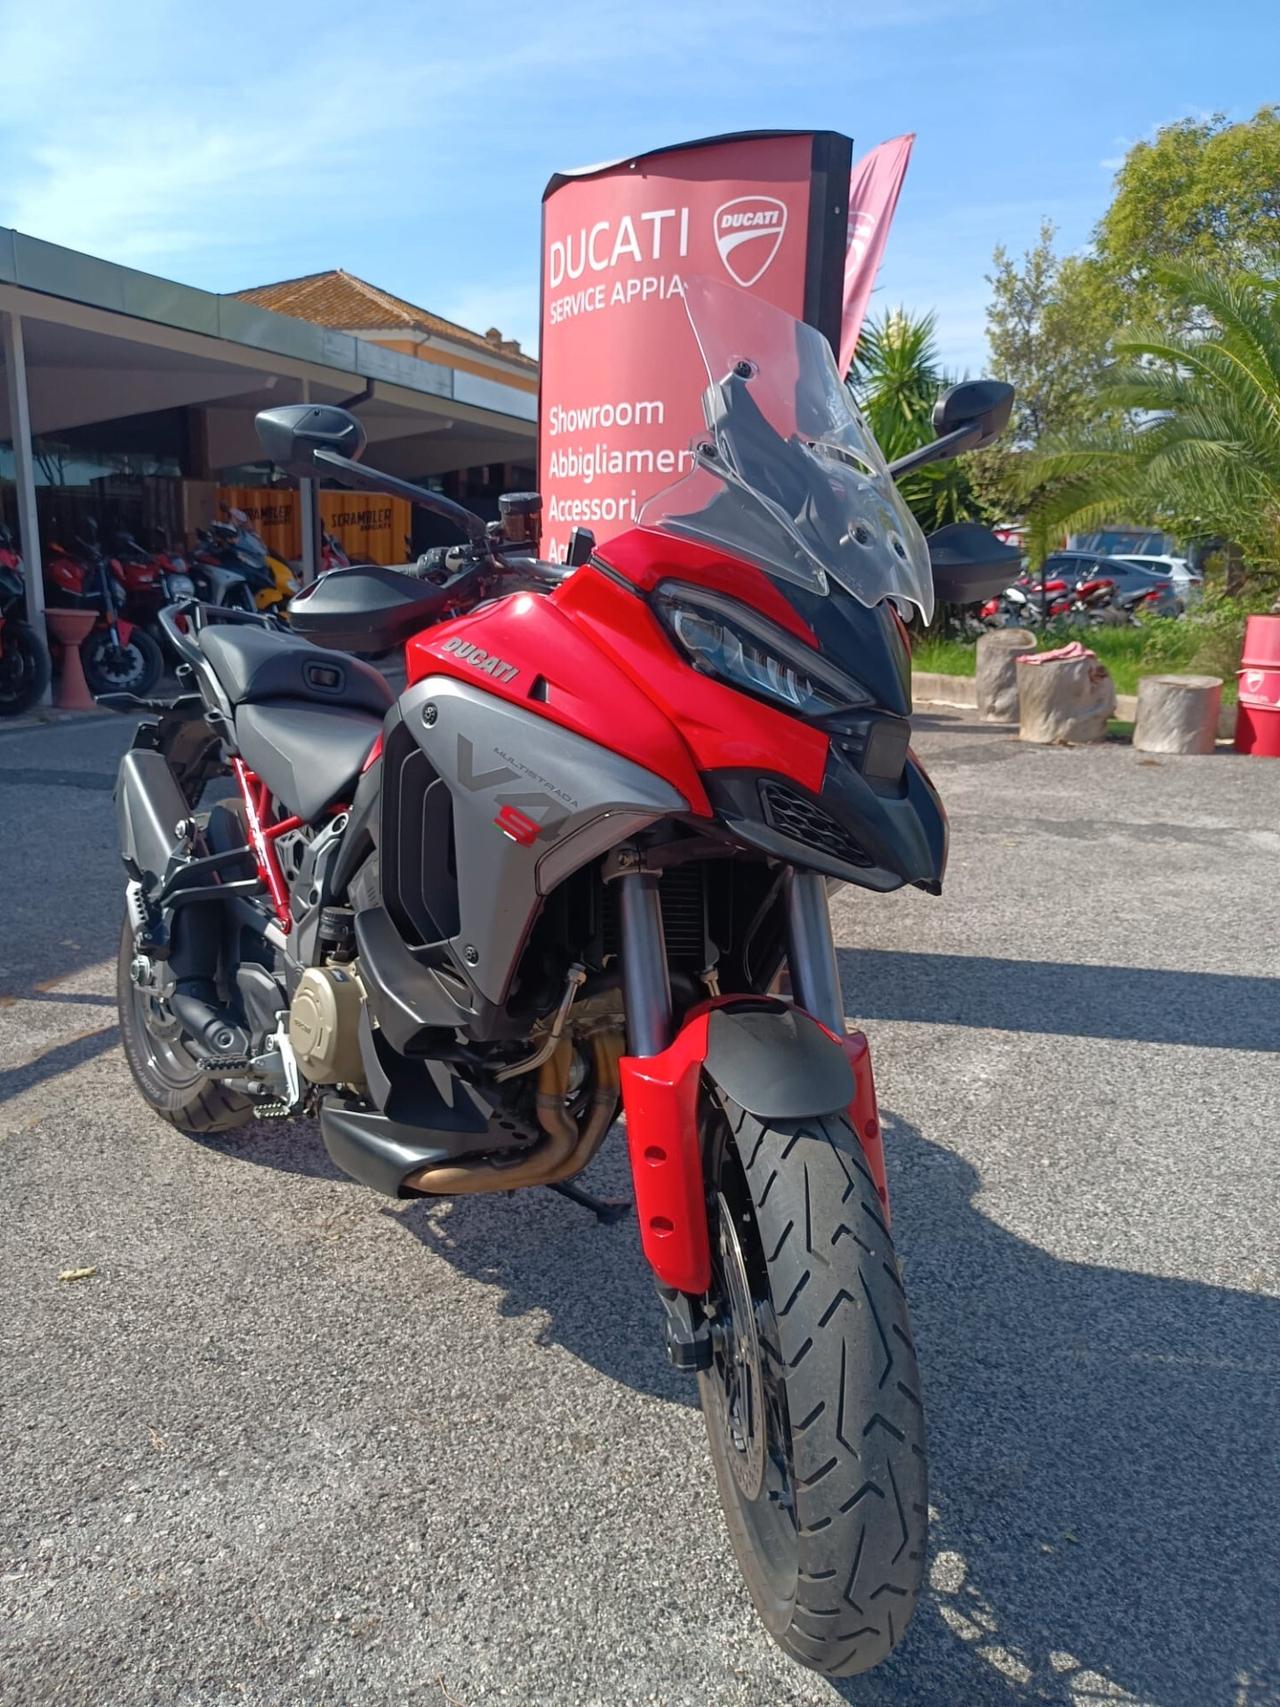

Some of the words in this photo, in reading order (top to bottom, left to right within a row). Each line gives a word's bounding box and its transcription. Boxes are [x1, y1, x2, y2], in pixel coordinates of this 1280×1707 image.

[721, 210, 779, 228] DUCATI
[550, 207, 689, 289] DUCATI
[550, 284, 606, 325] SERVICE
[610, 274, 685, 305] APPIA
[549, 400, 664, 436] Showroom
[331, 508, 392, 528] SCRAMBLER
[549, 489, 637, 522] Accessori
[441, 636, 520, 685] DUCATI
[493, 746, 580, 809] MULTISTRADA
